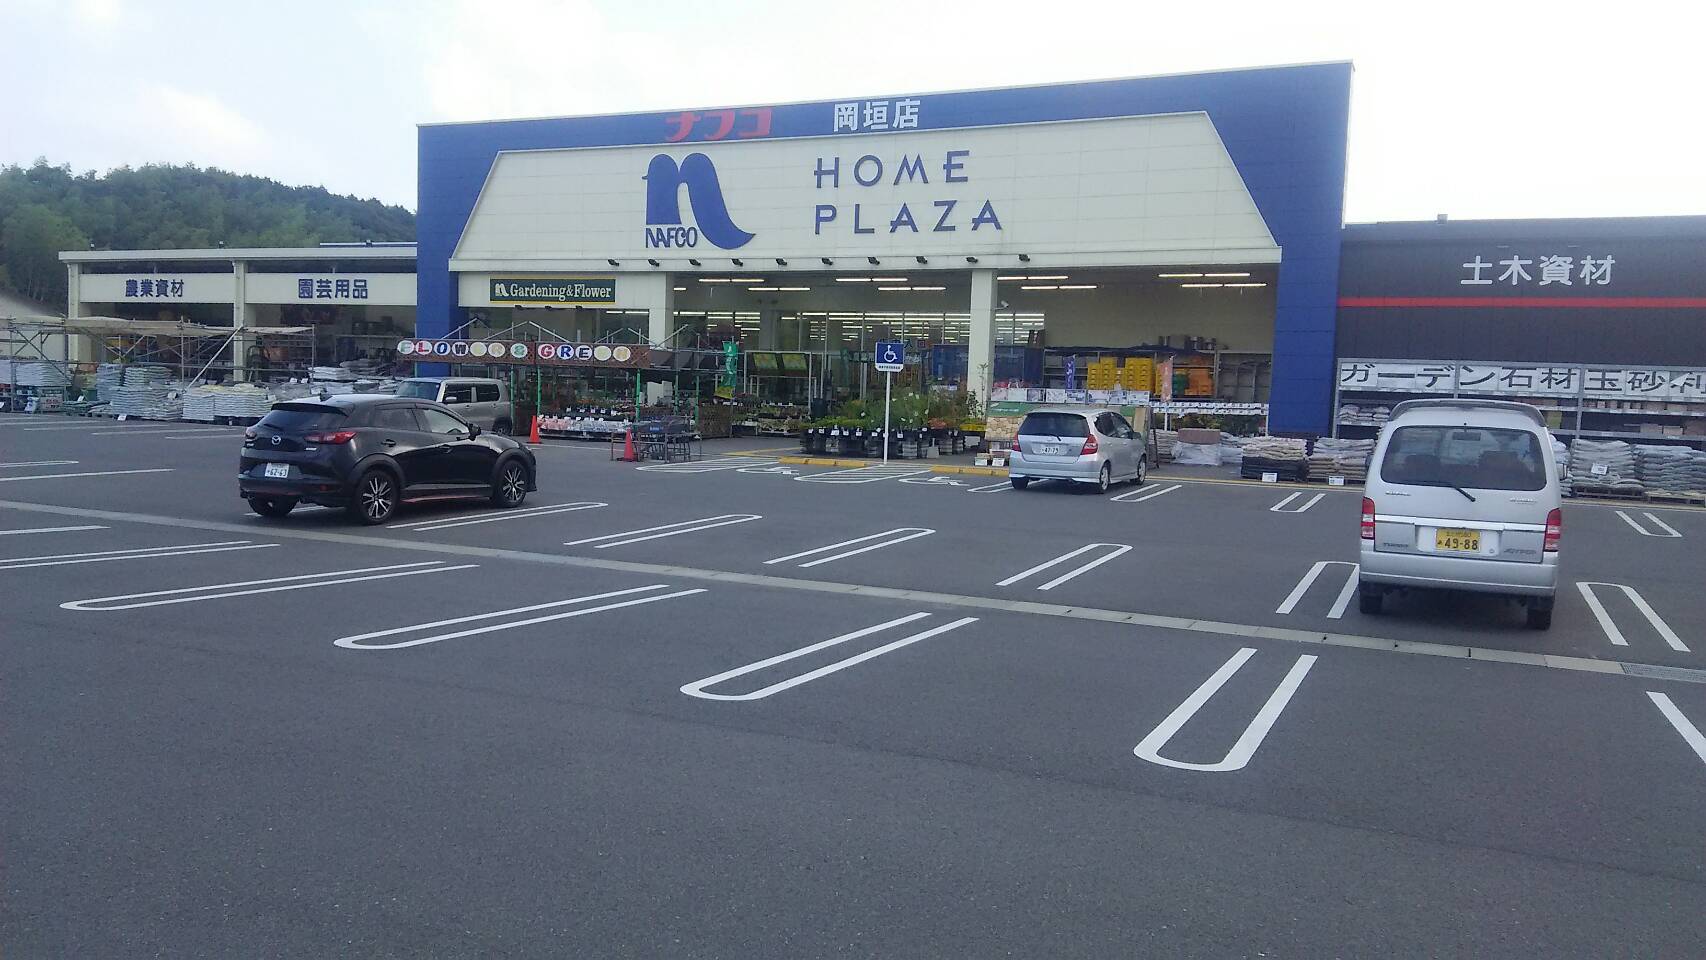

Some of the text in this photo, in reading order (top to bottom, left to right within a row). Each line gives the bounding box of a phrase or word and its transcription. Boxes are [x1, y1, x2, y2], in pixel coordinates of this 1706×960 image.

[664, 107, 772, 142] ナフコ
[833, 98, 921, 133] 岡垣店
[813, 150, 970, 189] HOME
[814, 199, 1003, 236] PLAZA
[645, 226, 698, 249] NAFCO
[1460, 254, 1616, 286] 土木資材
[125, 278, 185, 298] 農業資材
[298, 278, 368, 300] 園芸用品
[510, 283, 612, 302] Gardening&Flower
[1444, 537, 1479, 551] 49-88
